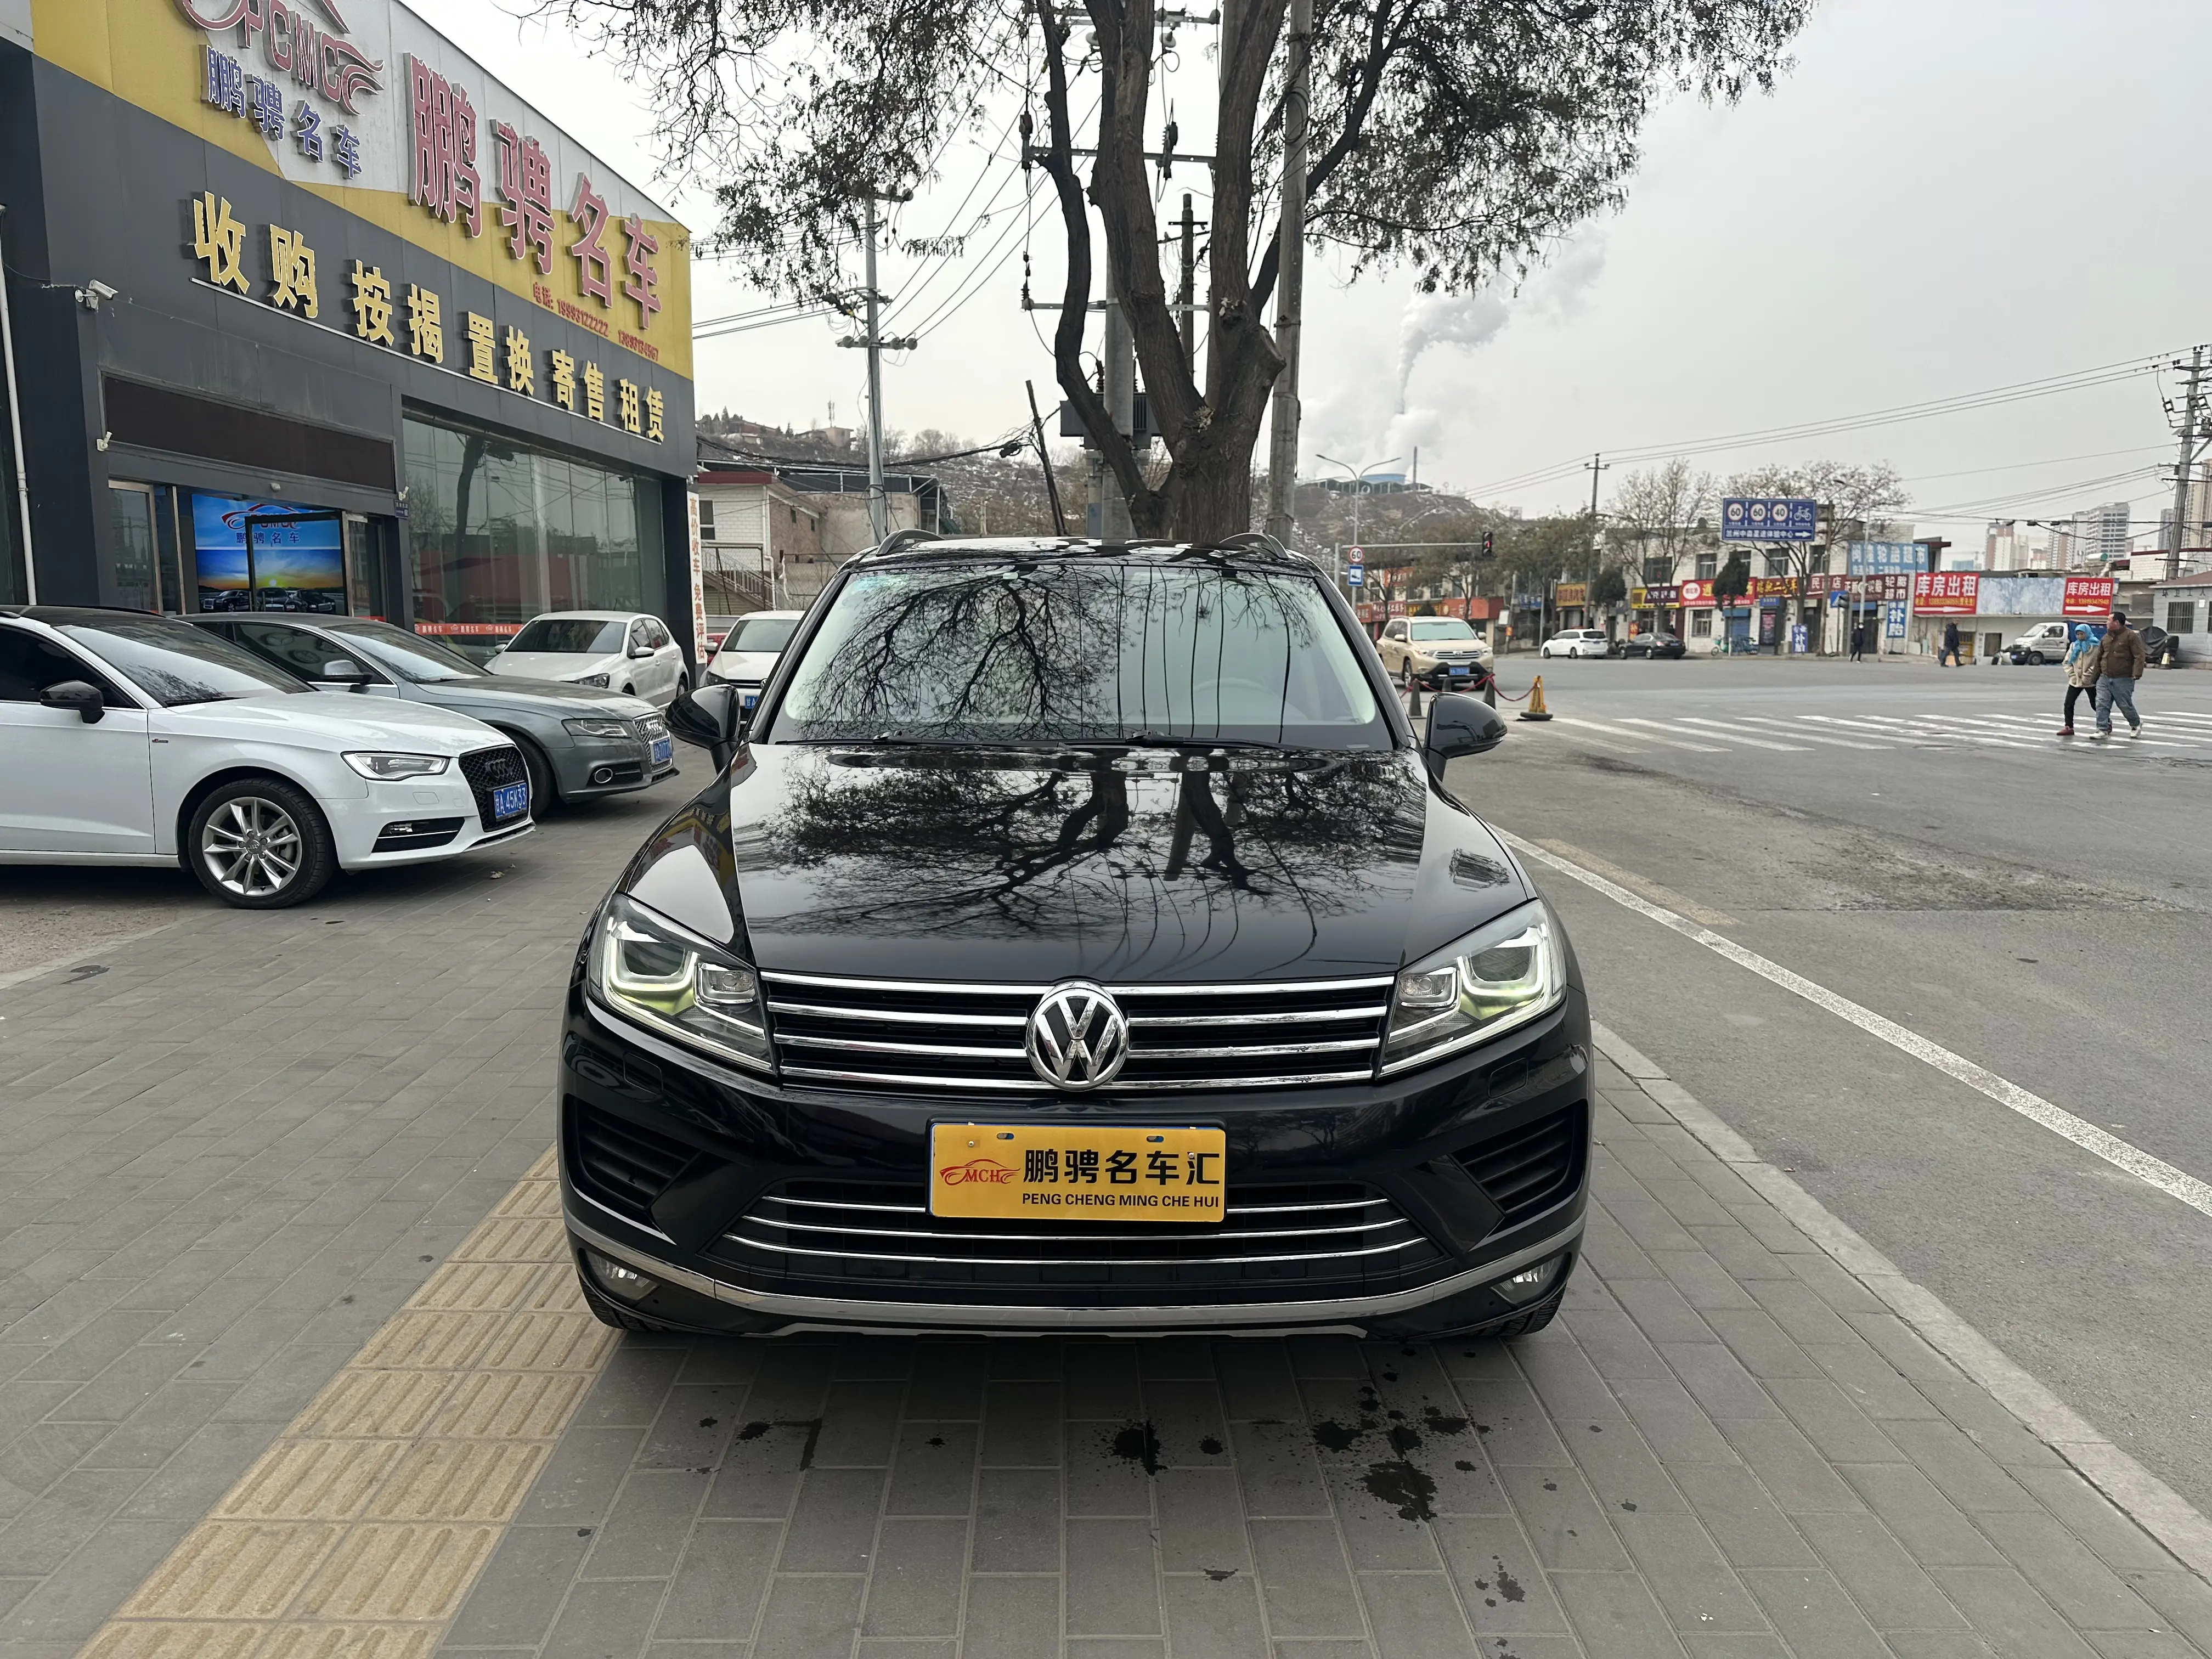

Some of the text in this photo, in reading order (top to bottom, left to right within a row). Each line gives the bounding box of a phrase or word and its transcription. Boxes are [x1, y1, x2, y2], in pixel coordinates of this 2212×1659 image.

[206, 44, 362, 179] 鹏骋名车
[409, 53, 662, 330] 鹏骋名车
[193, 190, 665, 443] 收购 按揭 置换 寄售 租赁
[1730, 507, 1785, 517] 60 60 40
[690, 496, 701, 576] 高价收车
[1351, 550, 1361, 559] 60
[1915, 574, 1976, 597] 库房出租
[2066, 582, 2111, 596] 库房出租
[694, 583, 705, 659] 免费评估
[1023, 1149, 1220, 1186] 鹏骋名车汇
[1022, 1192, 1220, 1208] PENG CHENG MING CHE HUI
